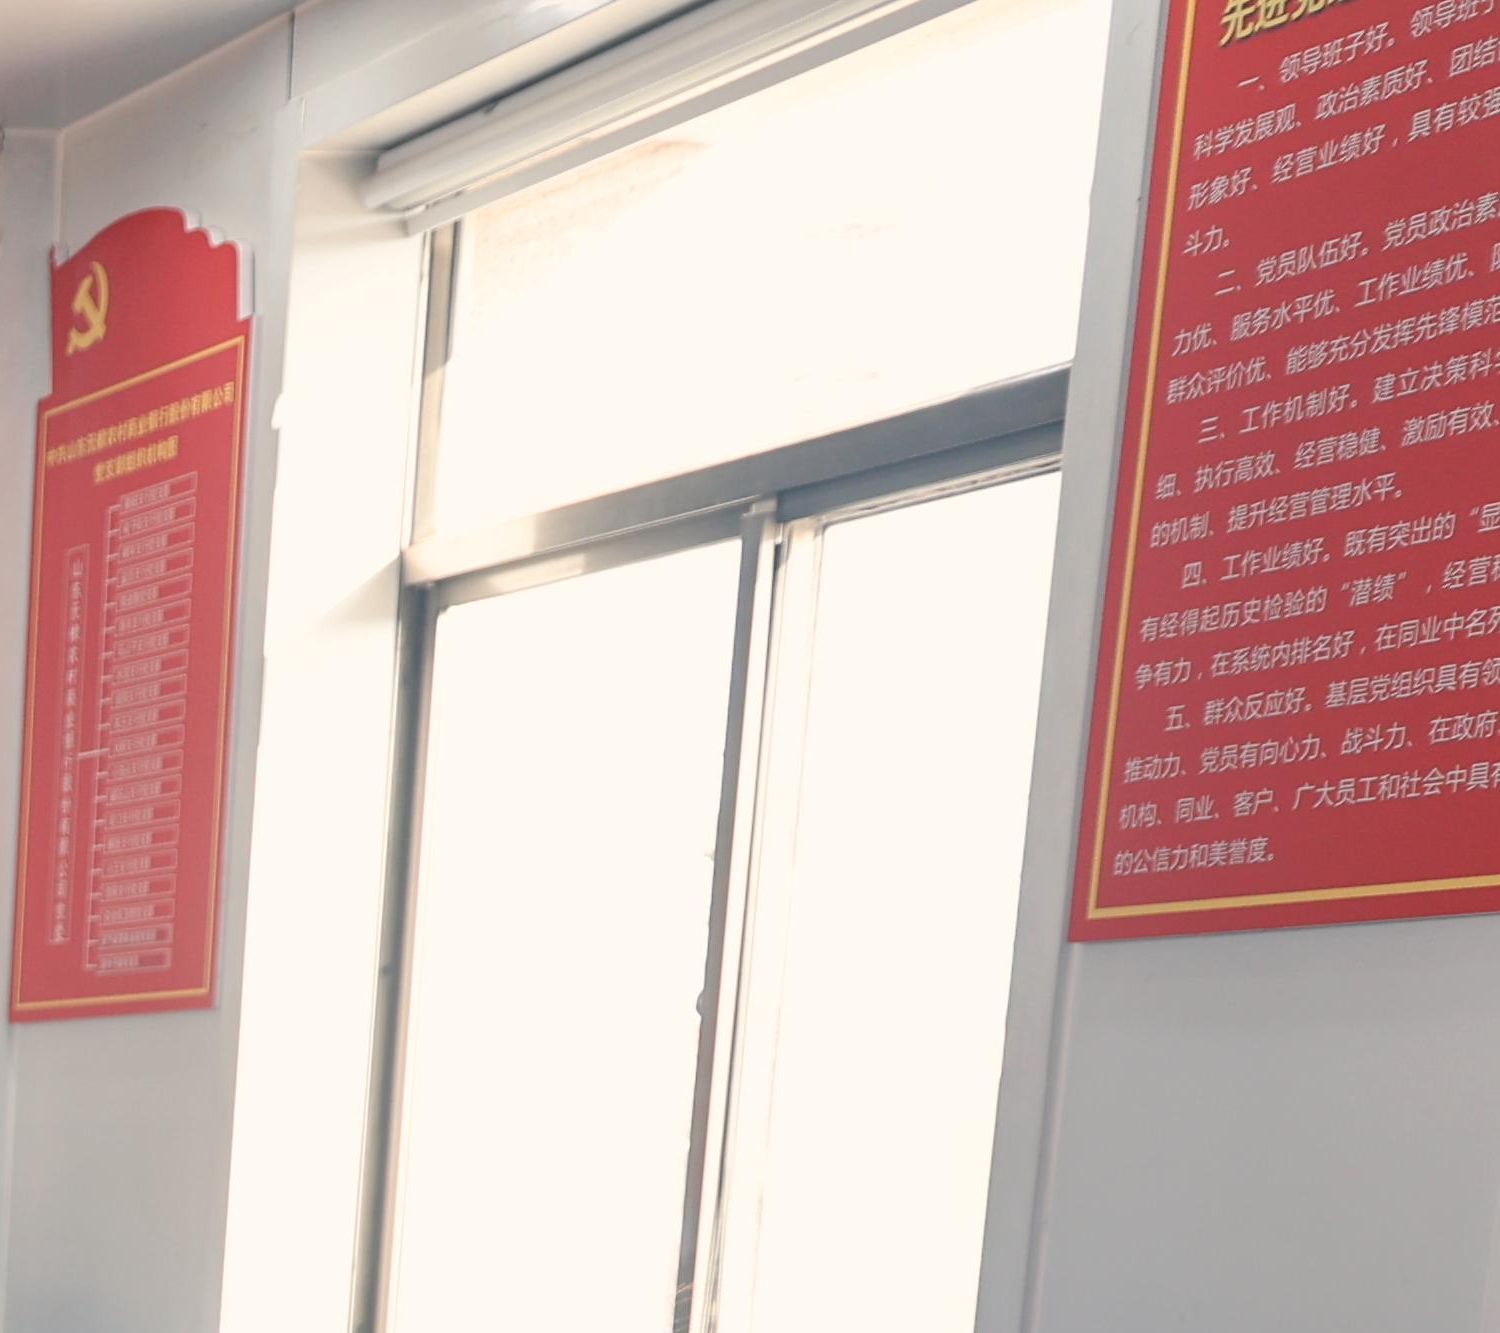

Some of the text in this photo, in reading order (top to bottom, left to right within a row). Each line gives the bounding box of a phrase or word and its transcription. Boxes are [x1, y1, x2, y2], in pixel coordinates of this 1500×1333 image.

[1219, 0, 1348, 46] 先进
[1193, 34, 1500, 161] 科学发展观、政治素质好、团结
[1181, 225, 1231, 257] 斗力。
[1214, 191, 1500, 297] 二、党员队伍好。党员政治素
[1197, 346, 1500, 444] 三、工作机制好。建立决策科
[1150, 472, 1403, 548] 的机制、提升经营管理水平。
[1113, 836, 1276, 876] 的公信力和美誉度。
